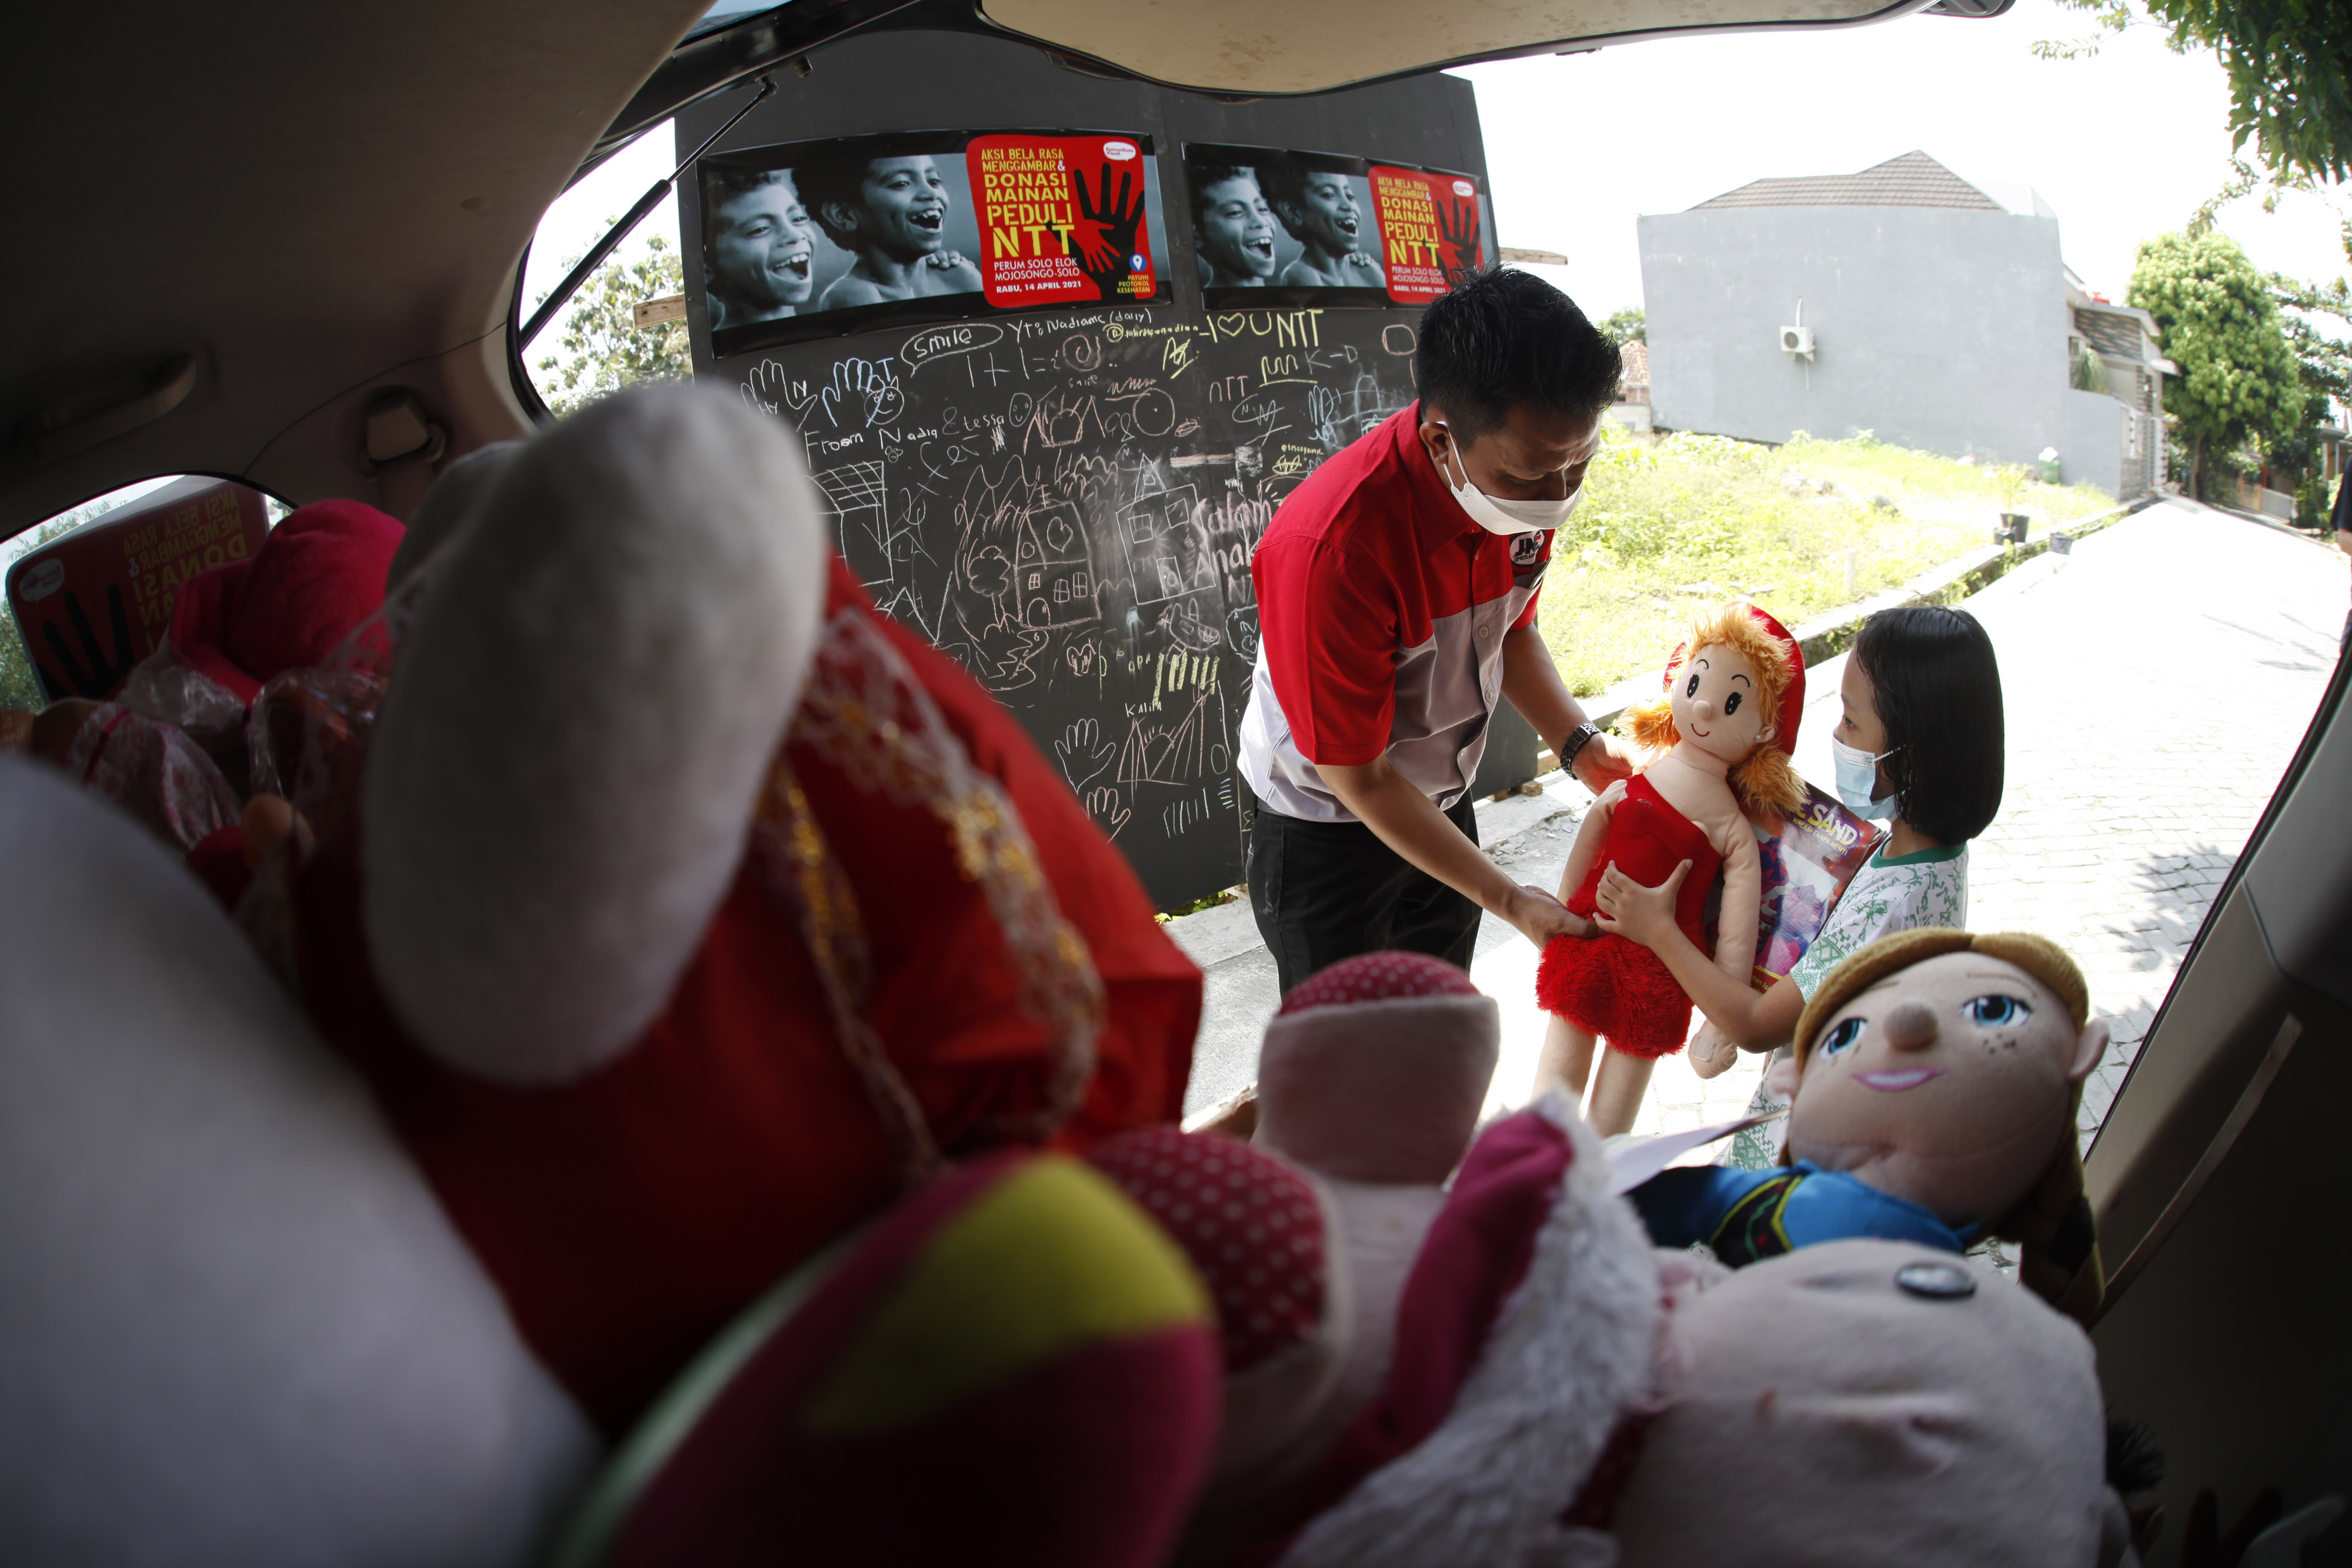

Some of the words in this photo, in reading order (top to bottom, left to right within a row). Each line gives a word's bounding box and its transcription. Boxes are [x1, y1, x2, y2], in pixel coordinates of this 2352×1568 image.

[981, 149, 1004, 160] AKSI
[1009, 148, 1035, 159] BELA
[1039, 148, 1064, 159] RASA
[983, 161, 1056, 172] MENGGAMBAR
[1058, 160, 1065, 171] &
[984, 173, 1067, 188] DONASI
[985, 188, 1069, 203] MAINAN
[1381, 196, 1433, 213] DONASI
[986, 203, 1073, 226] PEDULI
[1384, 209, 1435, 225] MAINAN
[1384, 221, 1438, 242] PEDULI
[993, 225, 1075, 258] NTT
[1389, 239, 1439, 267] NTT
[994, 260, 1025, 270] PERUM
[1027, 259, 1053, 269] SOLO
[1055, 258, 1078, 268] ELOK
[995, 268, 1080, 281] MOJOSONGO-SOLO
[996, 283, 1023, 293] RABU,
[1037, 282, 1061, 290] APRIL
[1808, 804, 1857, 845] SAND
[1792, 817, 1813, 833] KREASI
[1812, 830, 1830, 845] TANPA
[1830, 841, 1848, 856] HENTI
